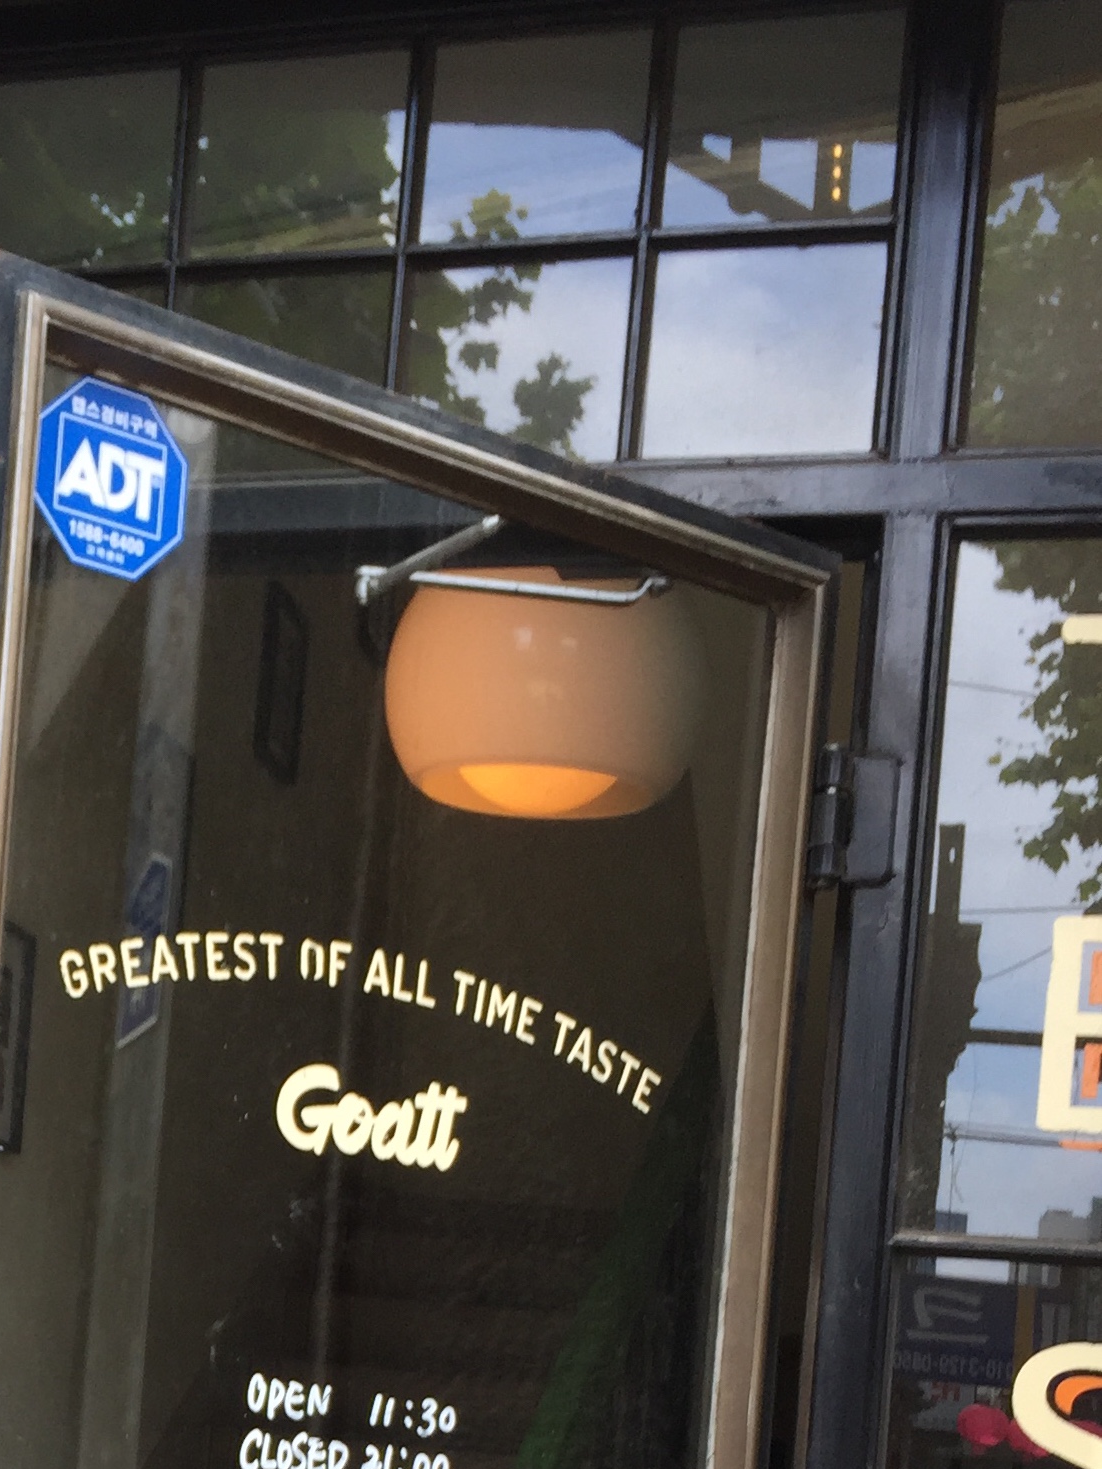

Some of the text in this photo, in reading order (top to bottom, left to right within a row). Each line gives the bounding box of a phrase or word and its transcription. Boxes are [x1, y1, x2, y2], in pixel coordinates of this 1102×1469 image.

[55, 437, 165, 523] ADT
[59, 931, 663, 1115] GREATEST OF ALL TIME TASTE
[275, 1062, 468, 1173] Goatt
[246, 1372, 457, 1437] OPEN 11:30
